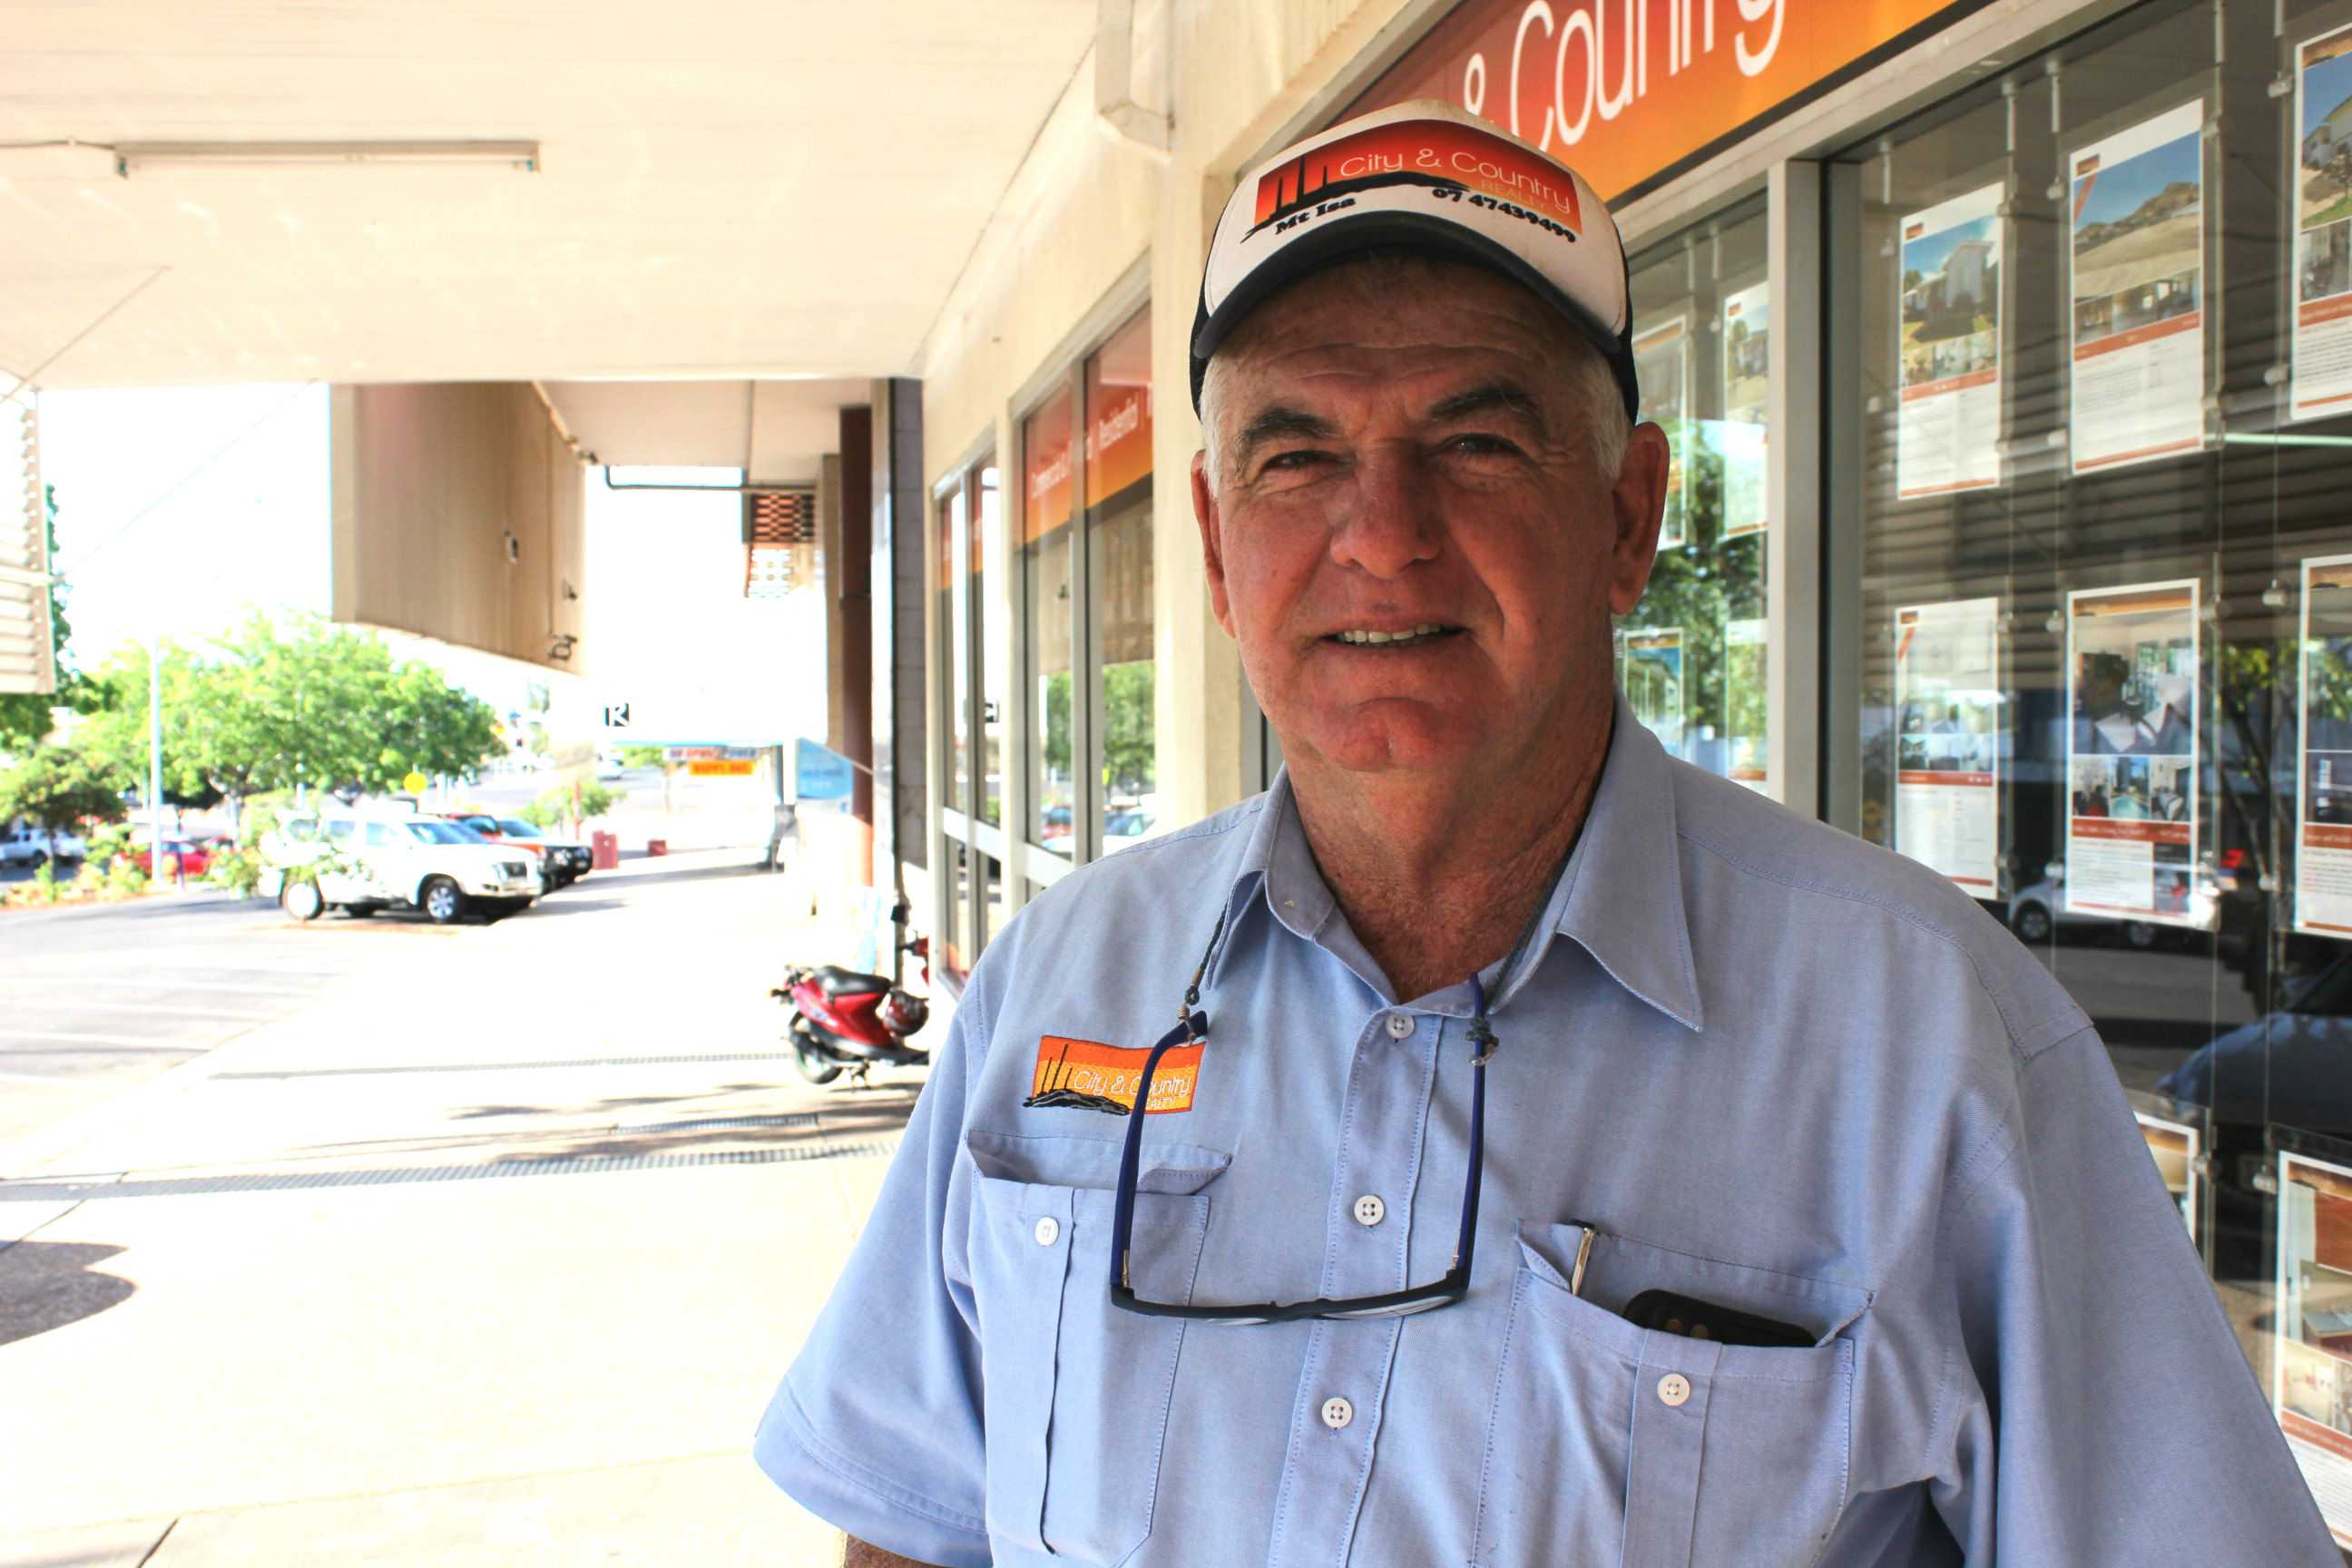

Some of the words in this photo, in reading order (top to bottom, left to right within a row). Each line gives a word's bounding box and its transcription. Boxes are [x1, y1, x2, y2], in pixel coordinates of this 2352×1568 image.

[1339, 152, 1404, 176] City
[1416, 148, 1443, 168] &
[1451, 152, 1571, 215] Country
[1481, 179, 1547, 210] REALTY
[1275, 210, 1311, 236] Mt
[1316, 196, 1357, 218] Isa
[1432, 187, 1463, 203] 07
[1468, 193, 1576, 243] 47439499
[1073, 1070, 1108, 1096] City
[1110, 1073, 1125, 1094] &
[1130, 1074, 1191, 1097] Cuntry
[1146, 1096, 1177, 1111] ALTY
